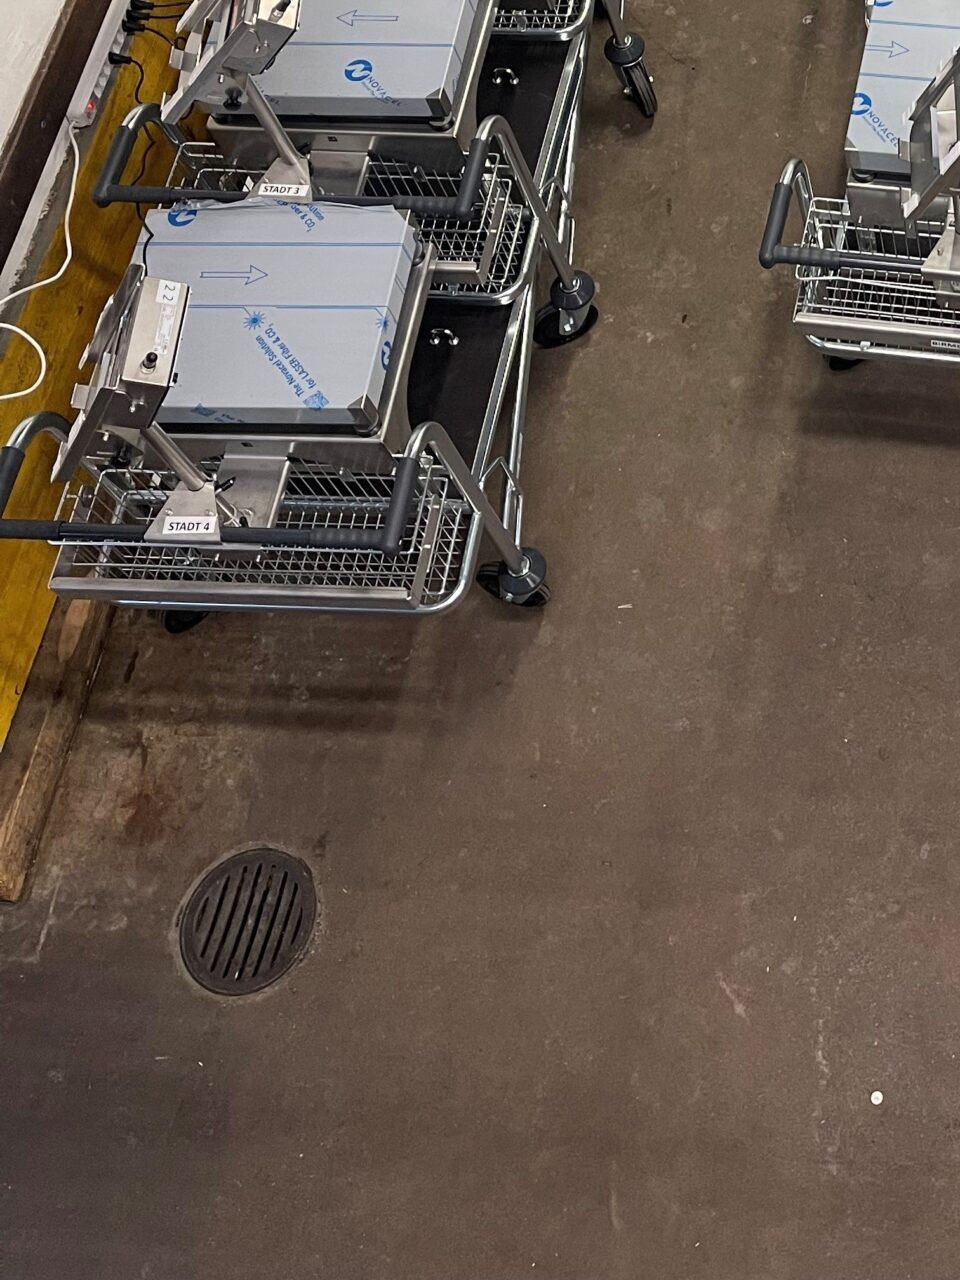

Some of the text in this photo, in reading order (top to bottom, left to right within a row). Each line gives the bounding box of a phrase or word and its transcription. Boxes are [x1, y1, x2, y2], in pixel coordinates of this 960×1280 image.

[867, 111, 898, 147] NOVACEL
[263, 185, 292, 194] STADT
[162, 284, 175, 301] 22
[278, 342, 293, 360] Fiber
[256, 335, 305, 398] The Novacel Solution
[289, 357, 309, 380] LASER
[306, 378, 317, 389] for
[168, 522, 210, 531] STADT 4
